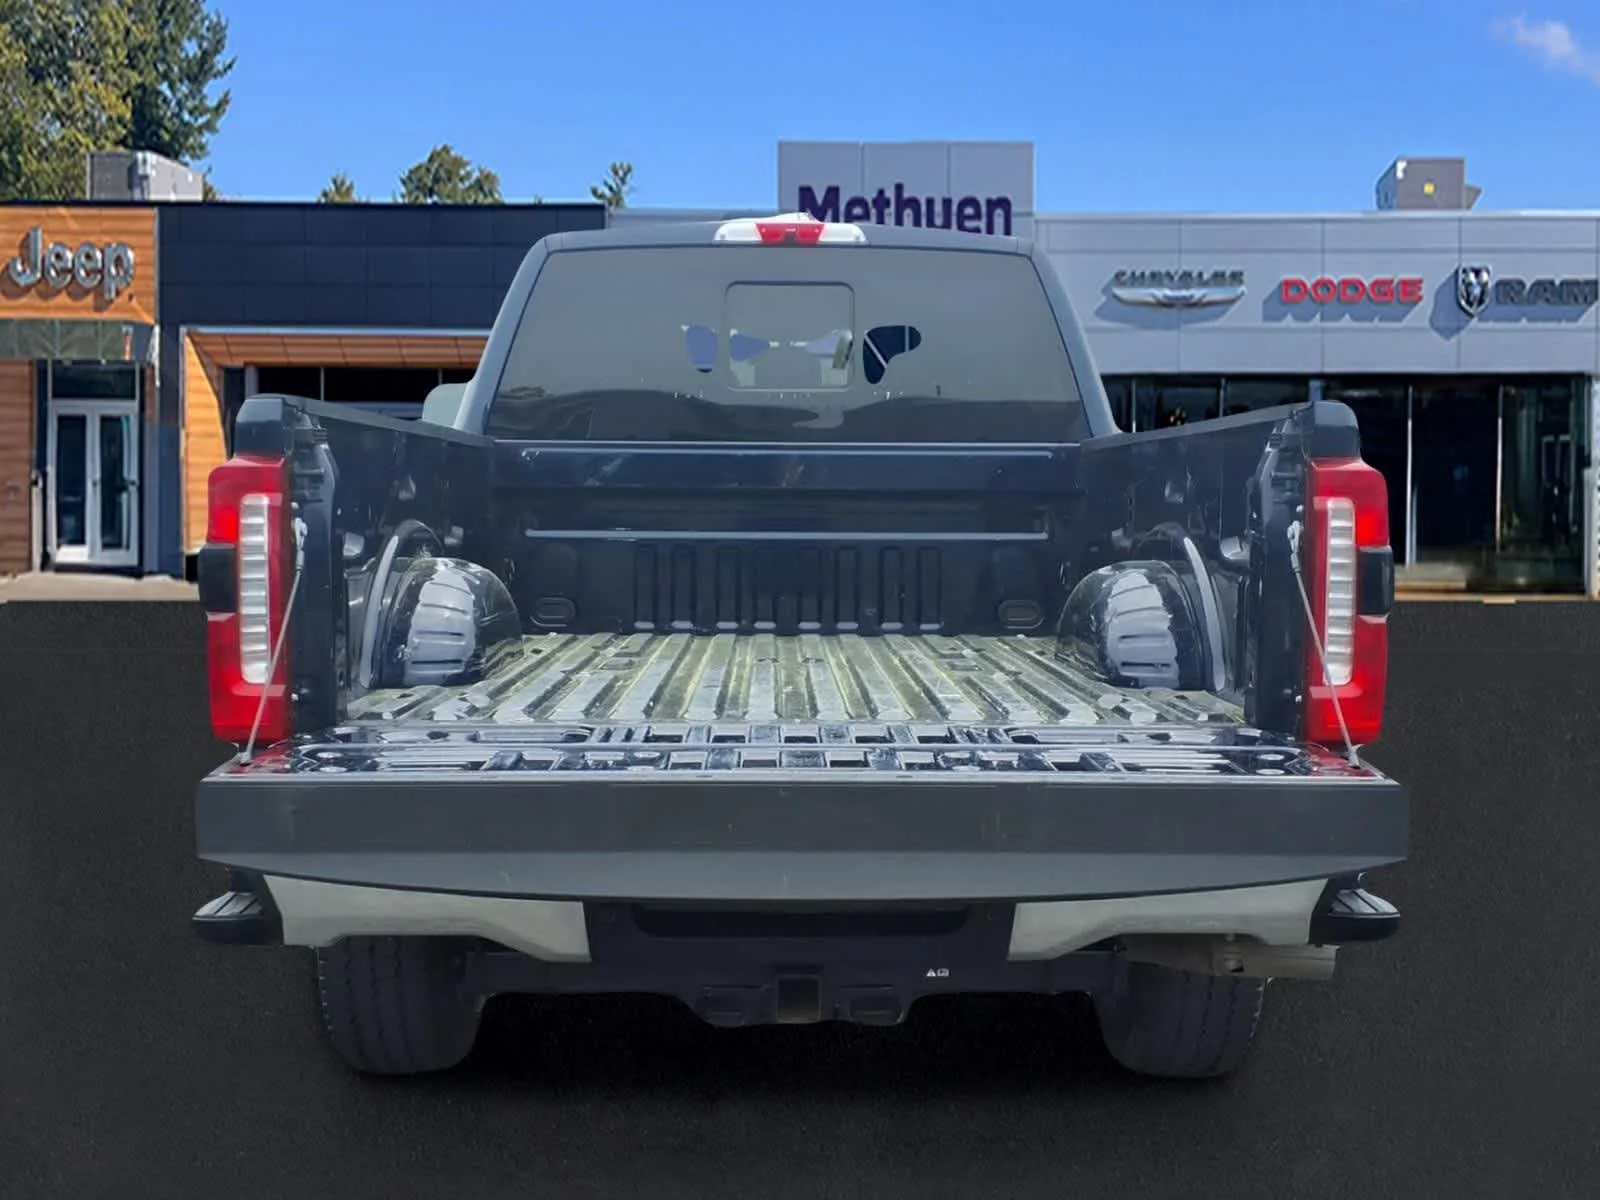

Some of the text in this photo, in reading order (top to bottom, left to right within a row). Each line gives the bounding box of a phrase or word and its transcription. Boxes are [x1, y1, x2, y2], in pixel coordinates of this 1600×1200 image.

[798, 182, 1012, 236] Methuen
[8, 226, 135, 300] Jeep
[1281, 276, 1424, 304] DODGE
[1494, 278, 1599, 305] RAM
